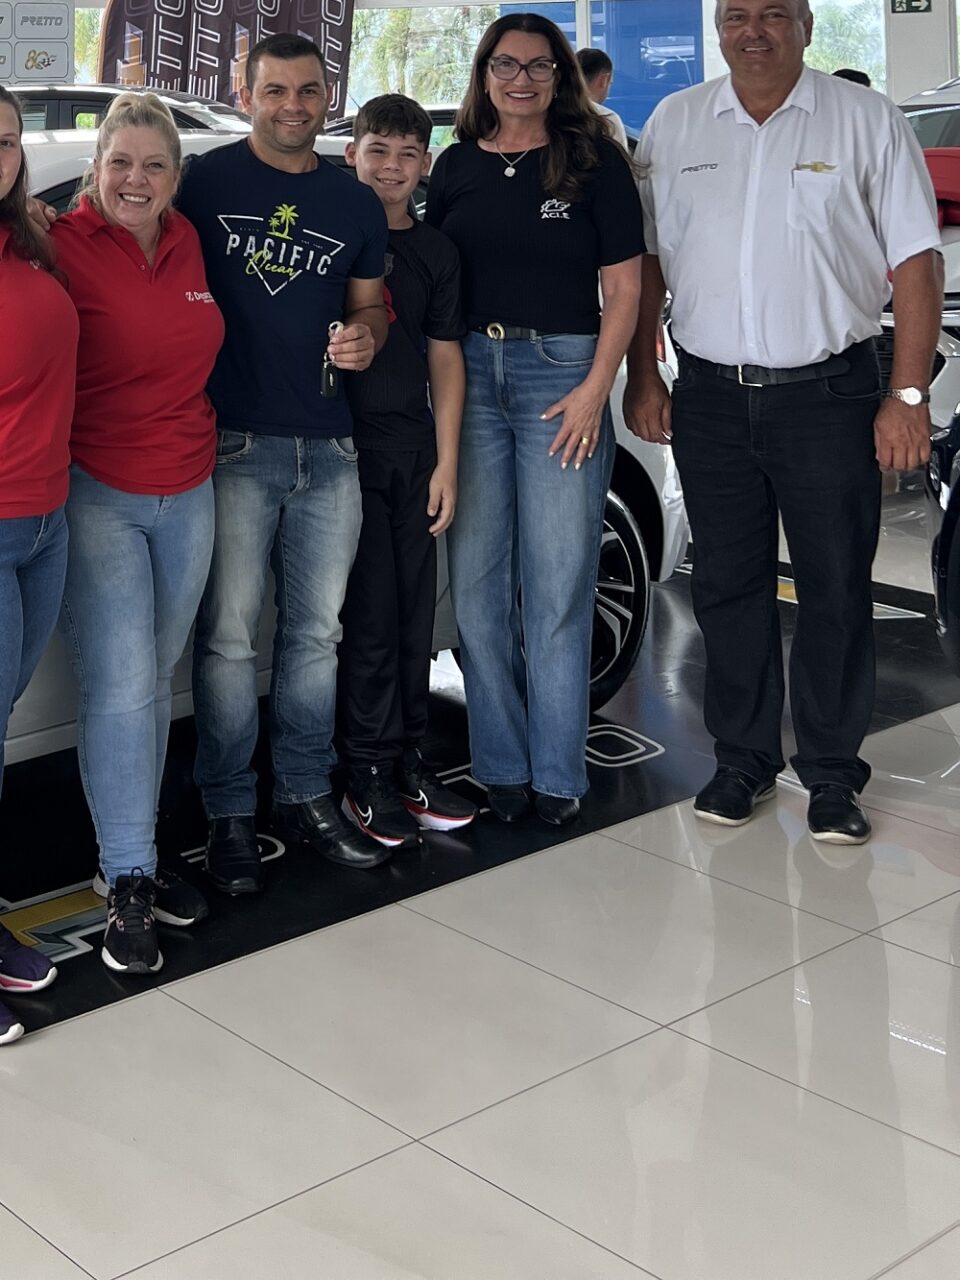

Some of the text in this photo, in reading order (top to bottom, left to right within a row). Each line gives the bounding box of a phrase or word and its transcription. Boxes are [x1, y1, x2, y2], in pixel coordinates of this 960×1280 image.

[20, 15, 64, 27] PRETTO
[226, 233, 333, 276] PACIFIC
[245, 247, 296, 277] Ocean
